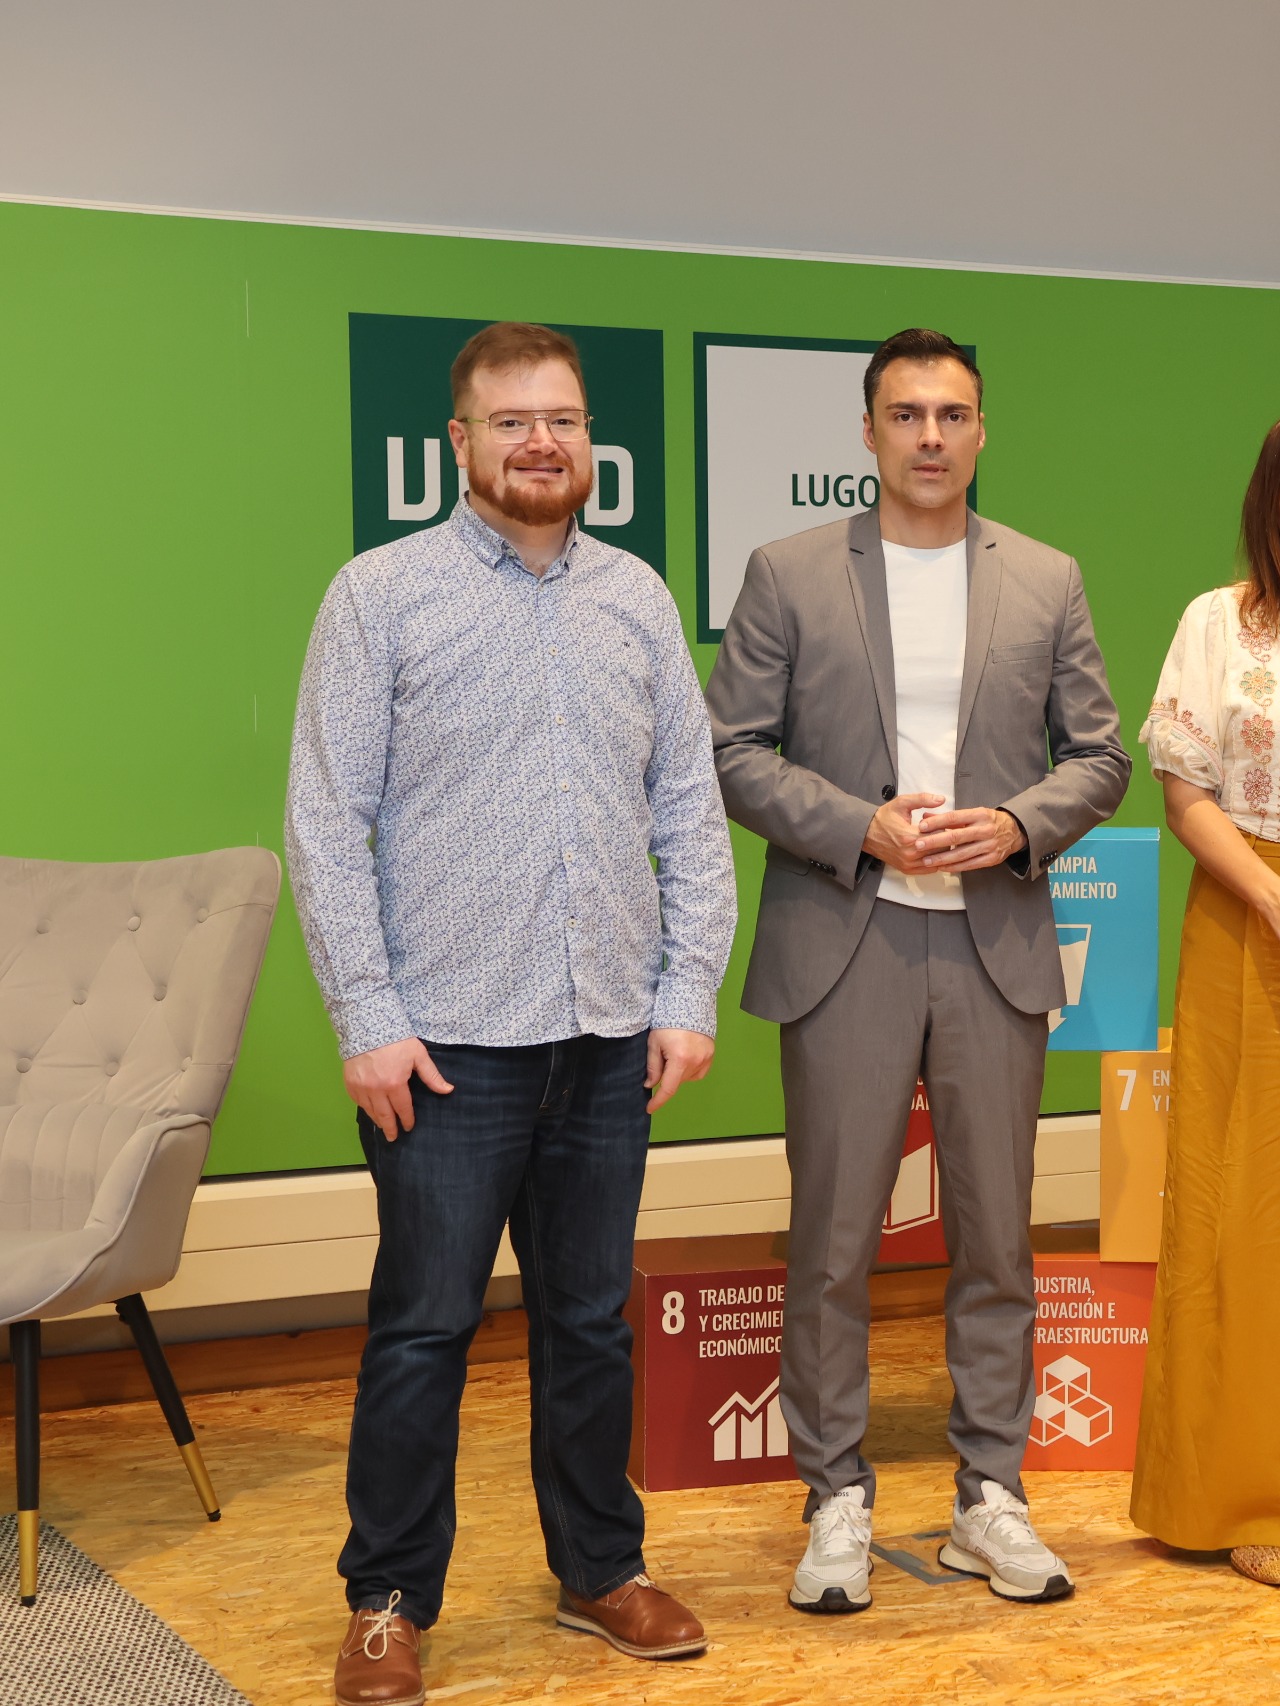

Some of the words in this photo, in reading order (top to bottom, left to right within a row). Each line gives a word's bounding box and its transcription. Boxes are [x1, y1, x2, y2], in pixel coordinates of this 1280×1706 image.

[386, 436, 634, 527] UD
[791, 473, 880, 508] LUGO
[1049, 882, 1117, 899] AMIENTO
[1116, 1069, 1137, 1111] 7
[699, 1285, 763, 1307] TRABAJO
[767, 1284, 785, 1302] DE
[1035, 1297, 1103, 1319] OVACIÓN
[1107, 1302, 1116, 1319] E
[661, 1290, 686, 1335] 8
[699, 1315, 709, 1333] Y
